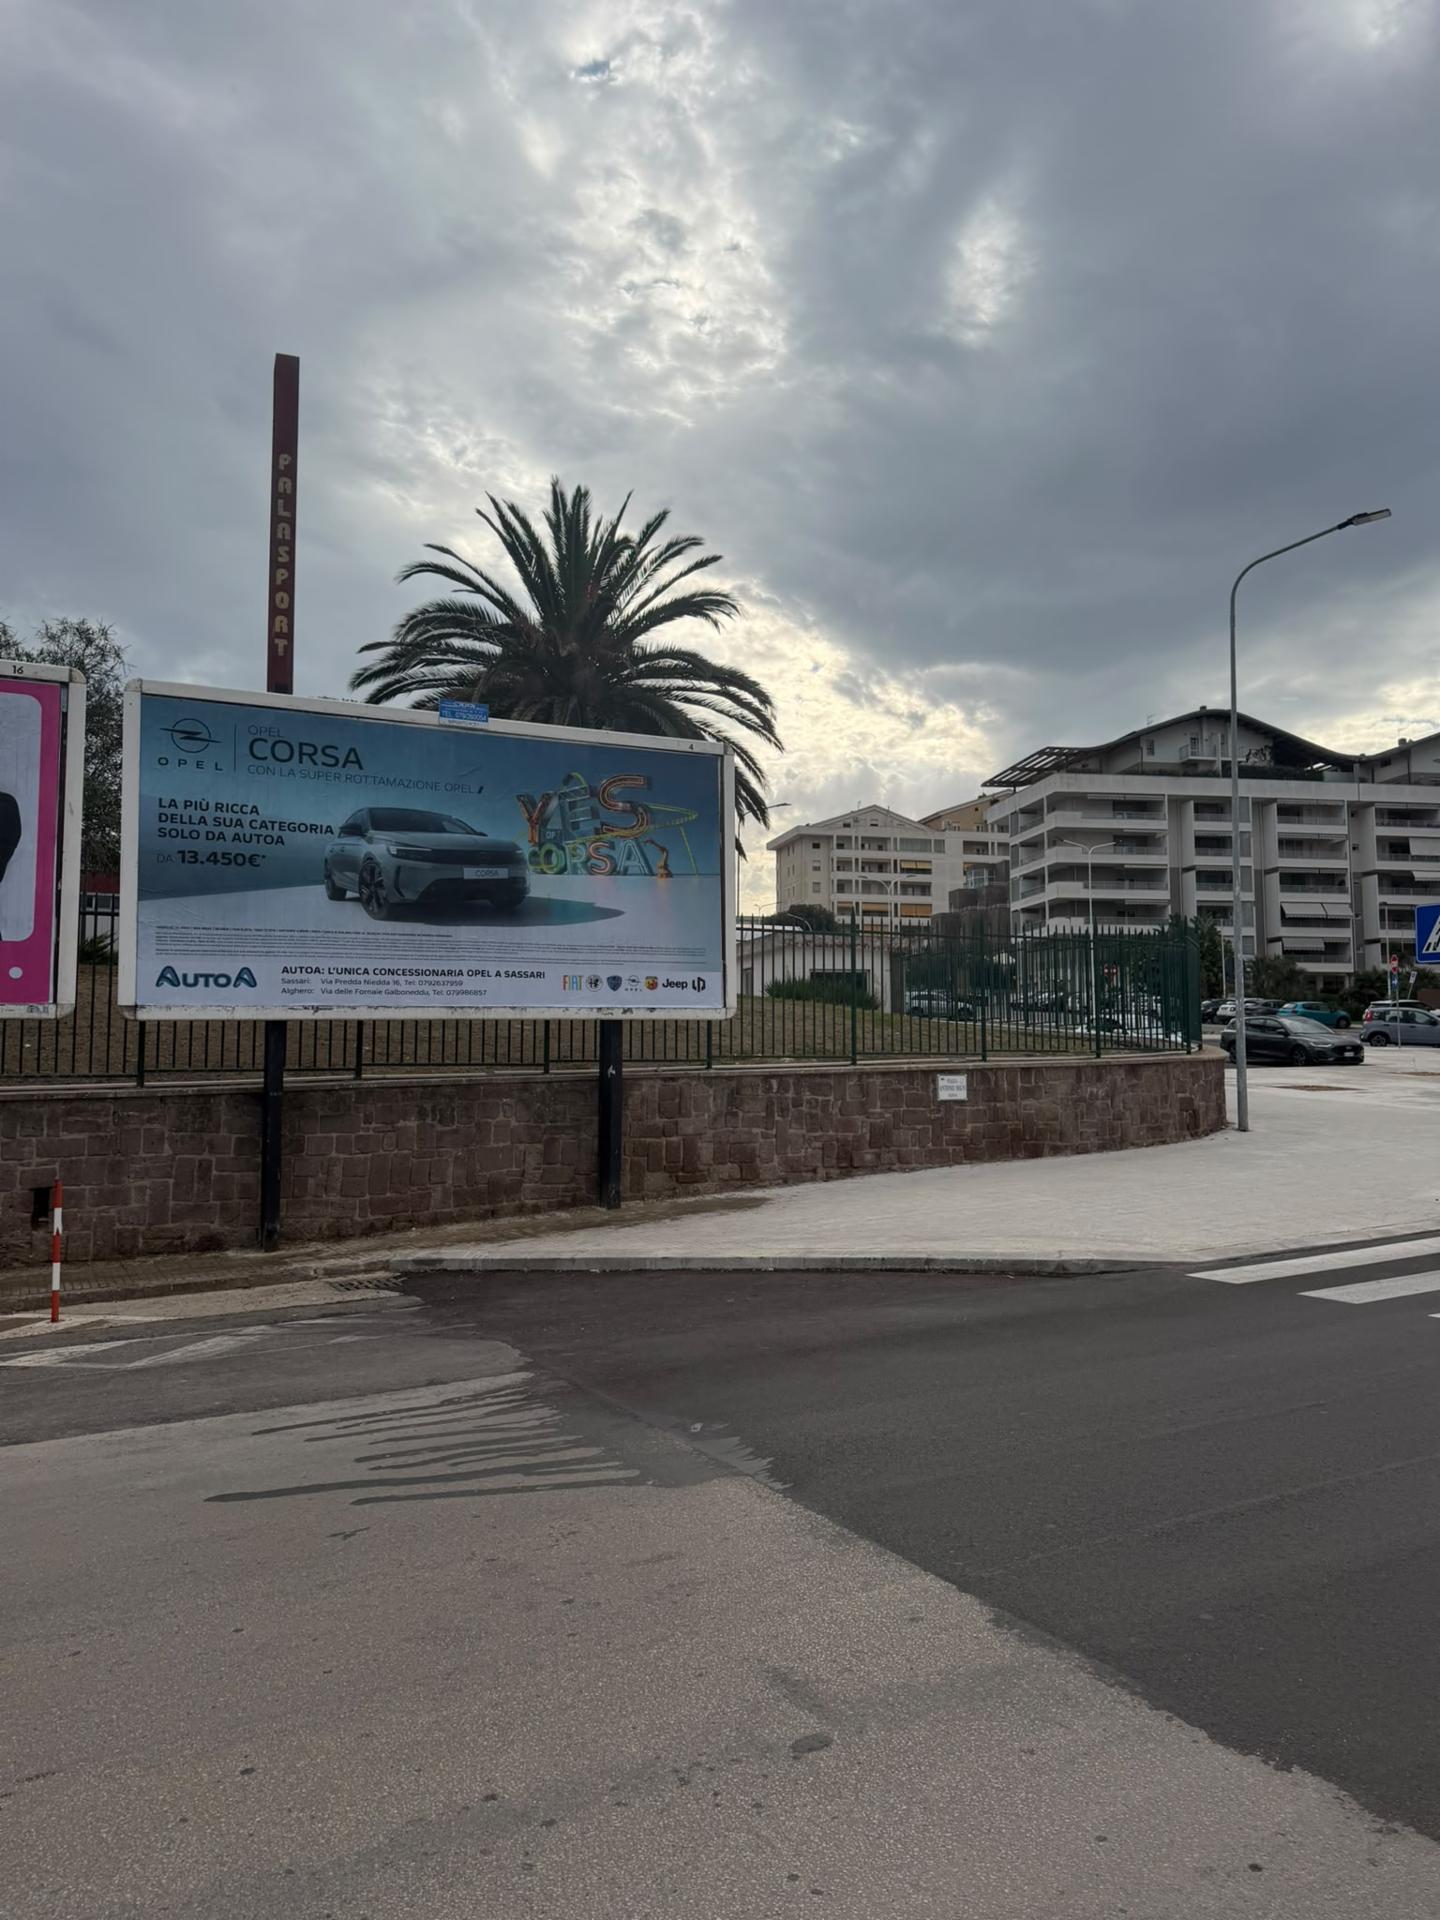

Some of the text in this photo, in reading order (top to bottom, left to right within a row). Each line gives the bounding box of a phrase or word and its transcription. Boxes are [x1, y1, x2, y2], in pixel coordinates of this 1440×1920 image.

[274, 453, 293, 656] PALASPORT
[12, 664, 24, 675] 16
[247, 724, 285, 738] OPEL
[248, 737, 364, 771] CORSA
[157, 756, 224, 772] OPEL
[247, 764, 276, 776] CON
[279, 767, 297, 778] LA
[300, 769, 342, 783] SUPER
[344, 774, 441, 792] ROTTAMAZIONE
[158, 798, 260, 816] LA PIÙ RICCA
[515, 774, 652, 844] YES
[158, 812, 335, 836] DELLA SUA CATEGORIA
[157, 827, 285, 846] SOLO DA AUTOA
[156, 853, 174, 864] DA
[527, 839, 656, 876] CORSA
[281, 966, 325, 975] AUTOA:
[328, 967, 370, 976] L'UNICA
[372, 968, 465, 977] CONCESSIONARIA
[467, 969, 492, 978] OPEL
[504, 971, 546, 979] SASSARI
[562, 974, 583, 992] FIAT
[662, 978, 688, 991] Jeep
